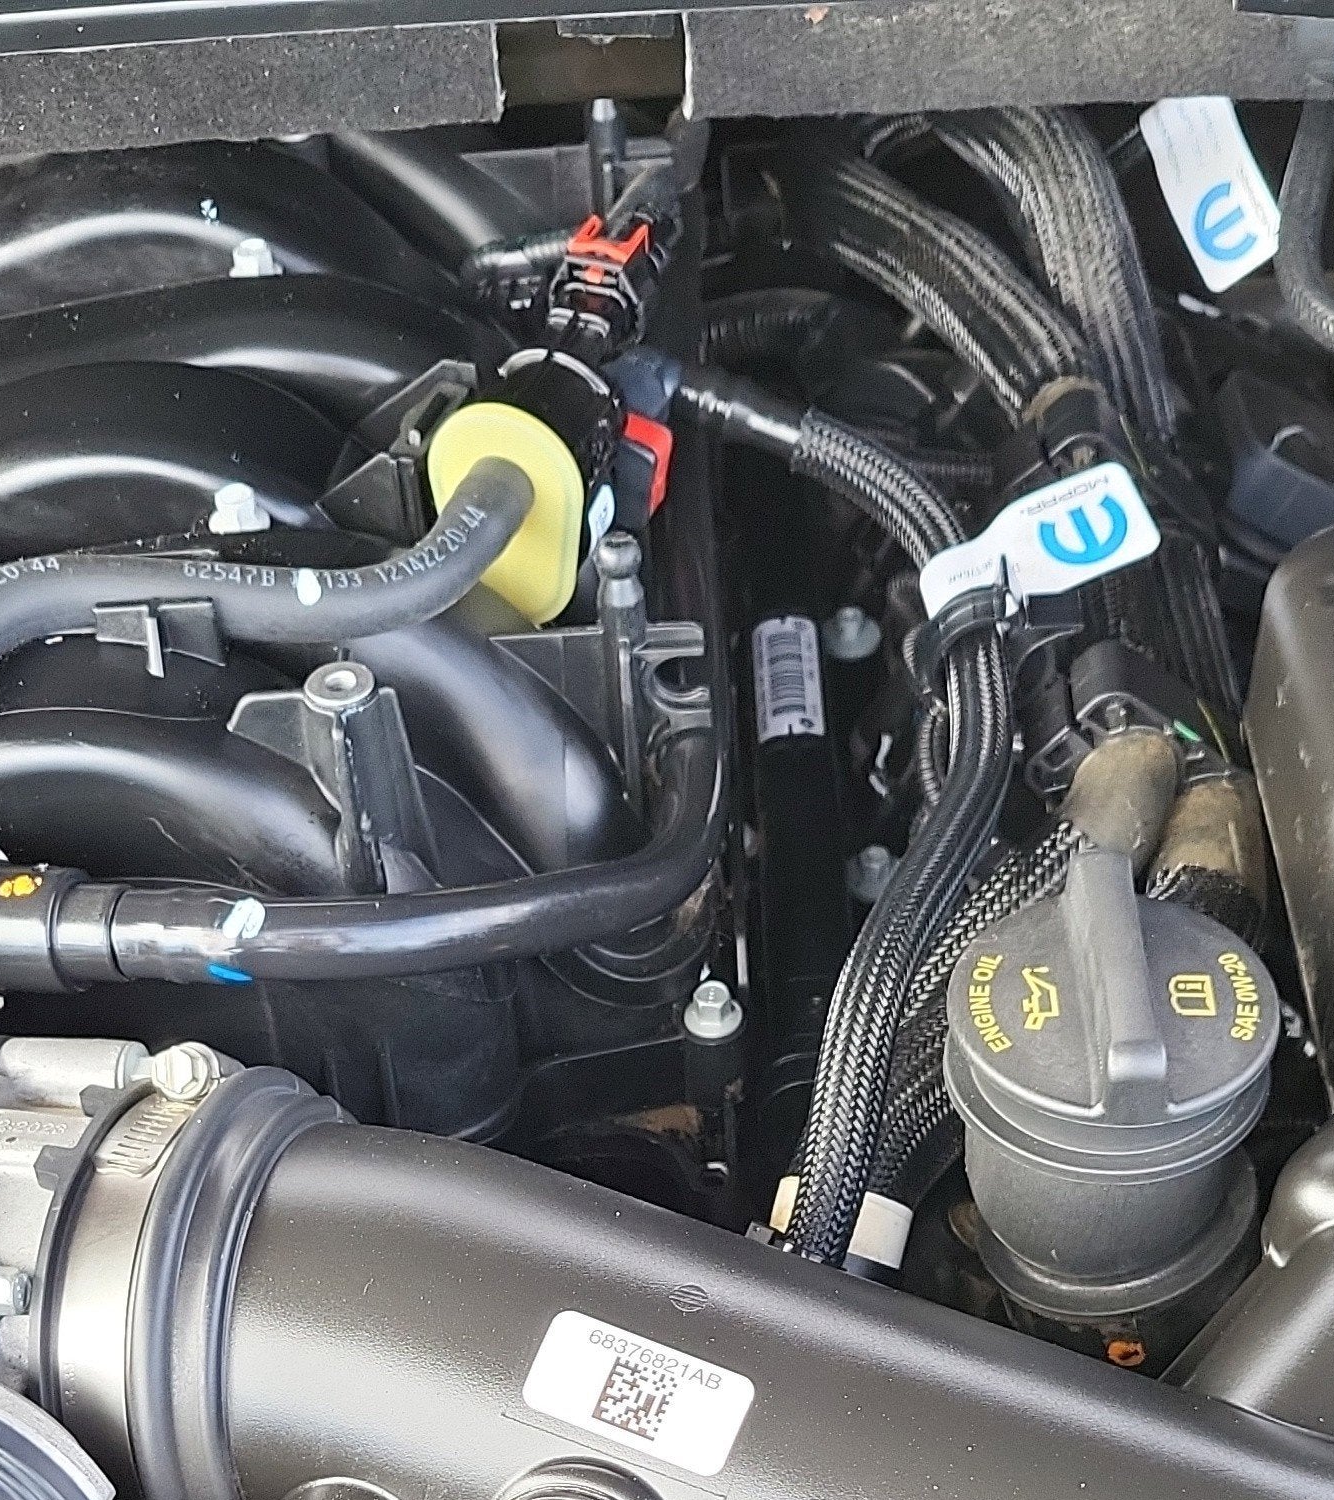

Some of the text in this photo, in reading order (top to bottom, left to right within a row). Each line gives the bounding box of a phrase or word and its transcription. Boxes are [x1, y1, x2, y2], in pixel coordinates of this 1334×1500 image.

[183, 563, 276, 587] 62547B
[290, 569, 363, 590] 133
[375, 552, 443, 585] 121422
[969, 953, 1013, 1053] ENGINE OIL
[1231, 1004, 1260, 1042] SAE
[589, 1329, 722, 1390] 68376821AB
